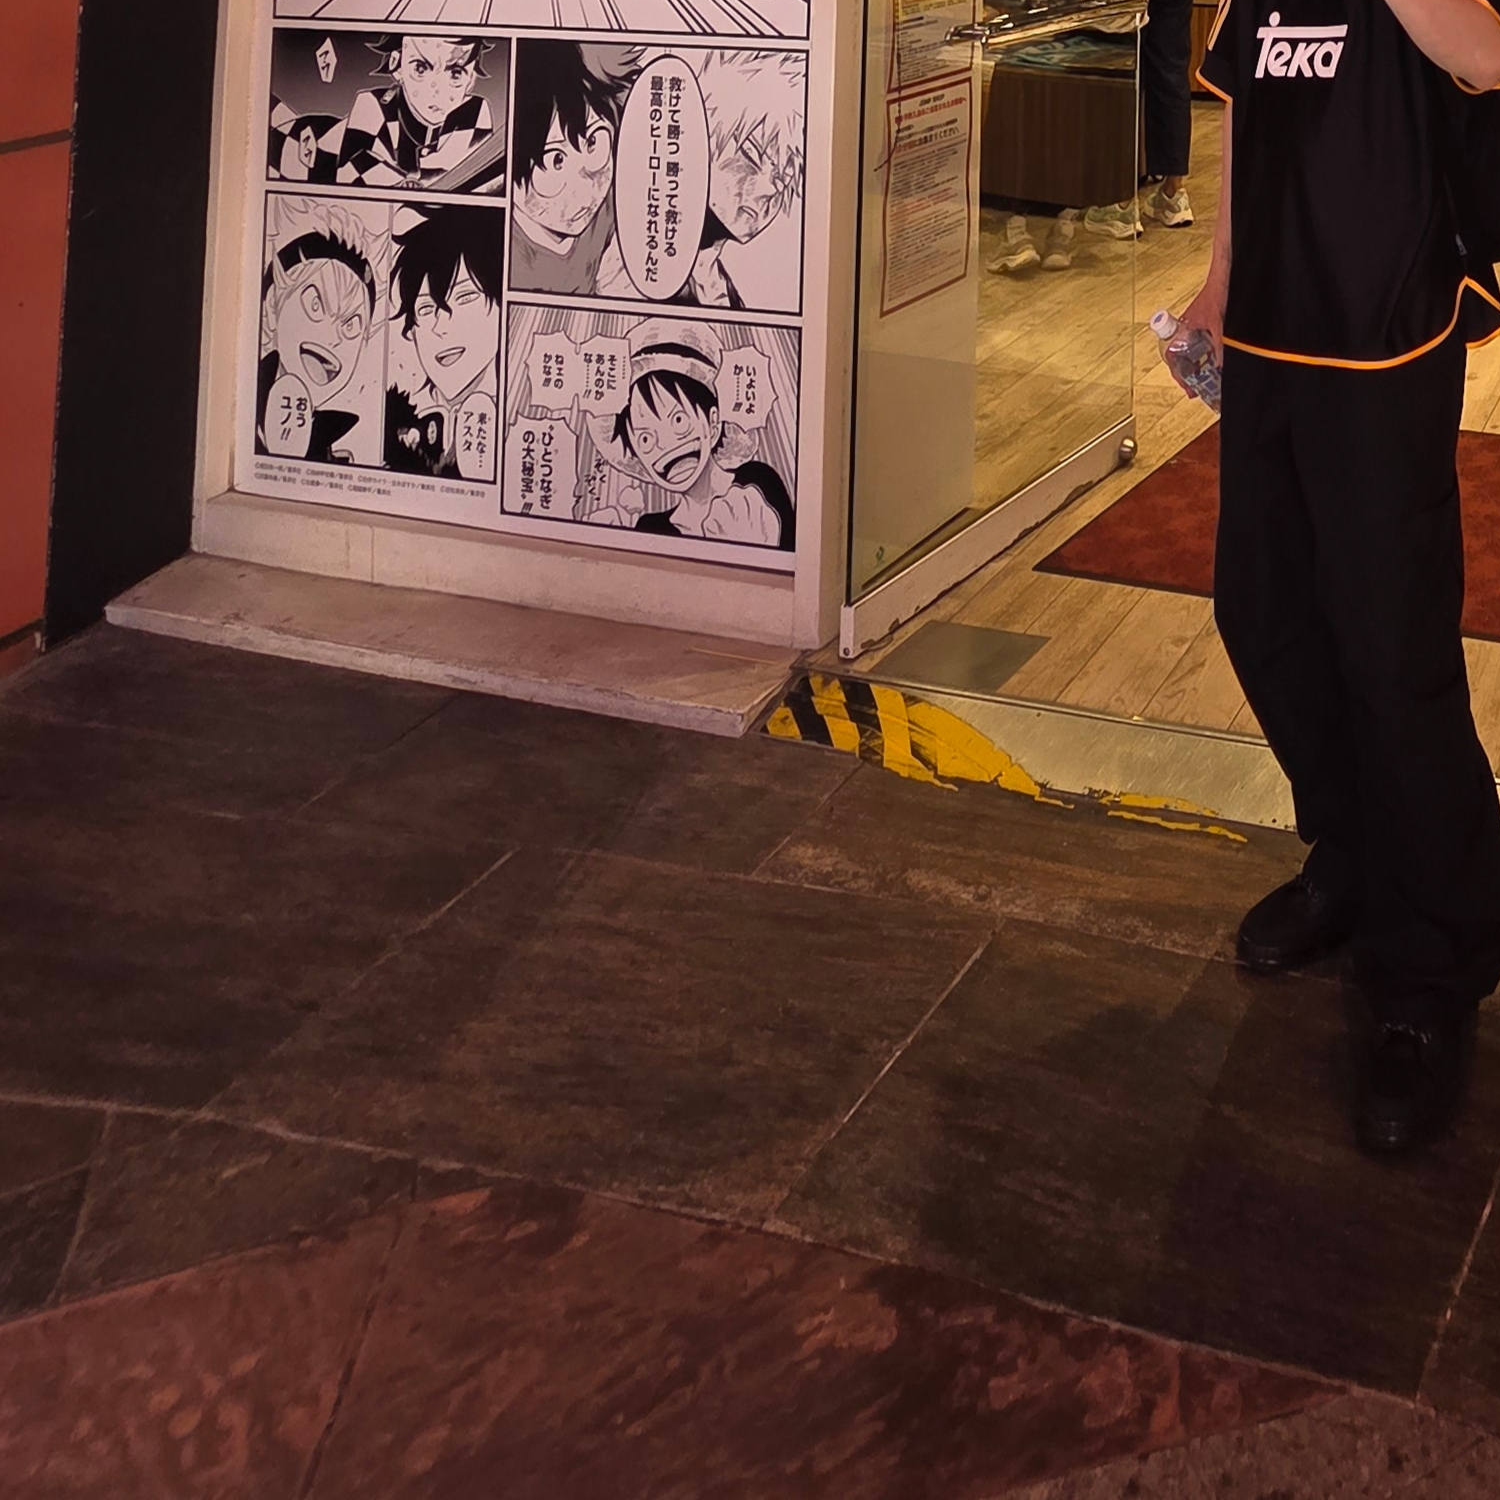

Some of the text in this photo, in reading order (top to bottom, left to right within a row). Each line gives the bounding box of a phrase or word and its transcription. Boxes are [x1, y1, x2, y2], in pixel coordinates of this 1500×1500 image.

[645, 75, 663, 283] 最高のヒーローになれるんだ
[296, 397, 308, 428] おう
[745, 365, 756, 415] いよいよ
